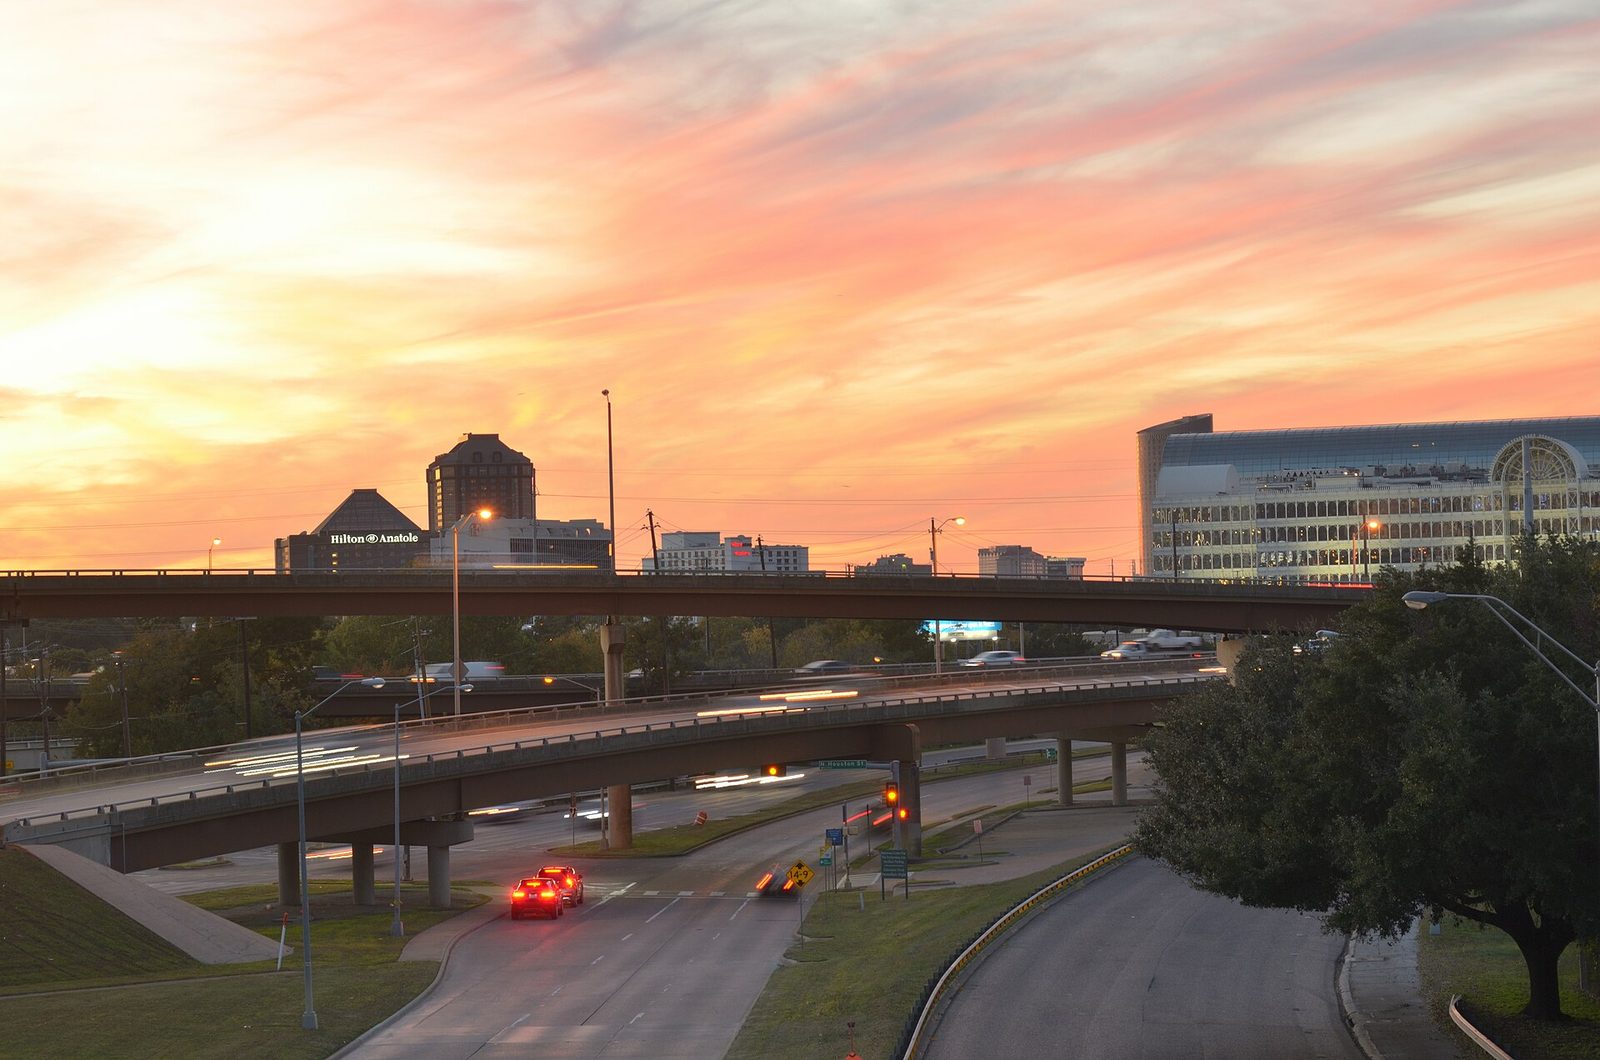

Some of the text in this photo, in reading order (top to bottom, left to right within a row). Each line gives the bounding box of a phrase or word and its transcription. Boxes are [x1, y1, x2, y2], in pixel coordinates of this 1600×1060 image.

[331, 532, 419, 544] Hilton Anatole
[790, 870, 809, 879] 14-9
